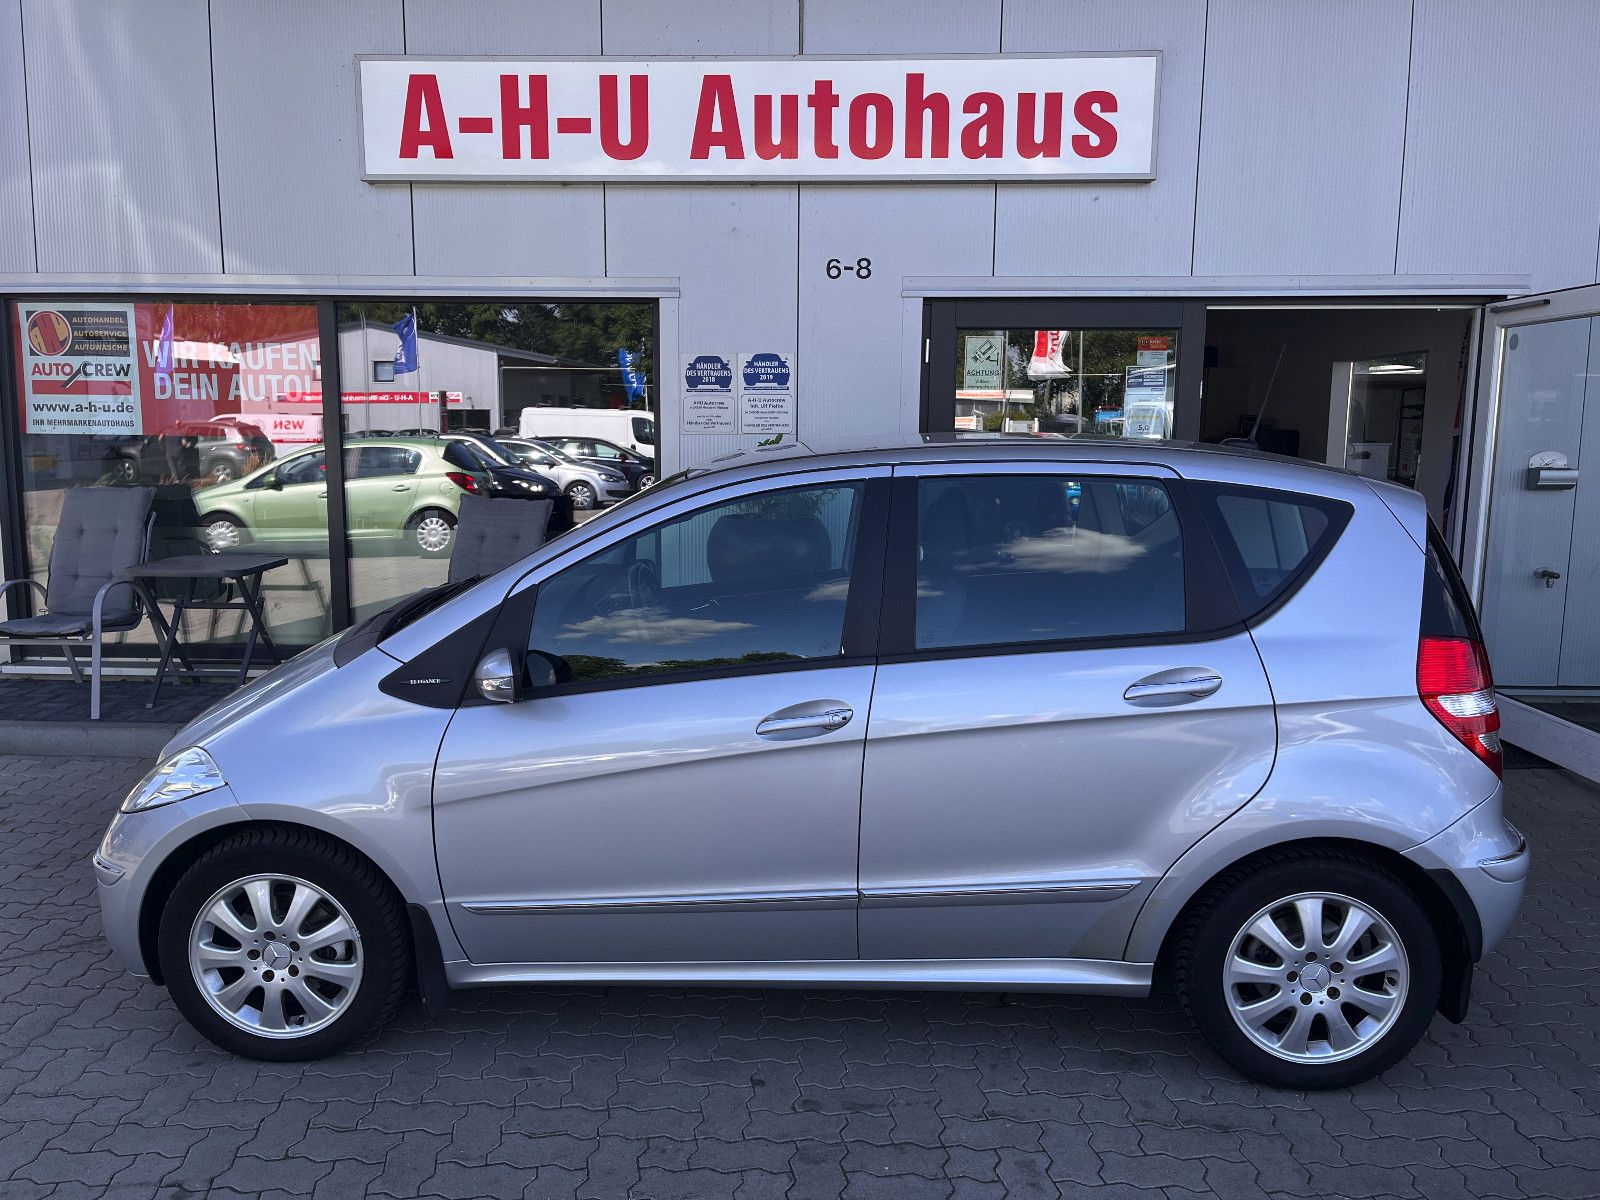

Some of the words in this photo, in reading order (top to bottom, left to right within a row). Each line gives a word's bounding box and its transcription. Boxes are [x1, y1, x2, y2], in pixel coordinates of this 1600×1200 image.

[398, 73, 649, 160] A-H-U
[690, 73, 1119, 160] Autohaus
[825, 257, 873, 280] 6-8
[72, 316, 125, 324] AUTOHANDEL
[143, 340, 199, 369] WIR
[207, 341, 318, 370] KAUFEN
[31, 362, 74, 376] AUTO
[81, 361, 131, 377] CREW
[153, 372, 219, 400] DEIN
[228, 374, 312, 402] AUTO!
[33, 401, 135, 413] www.a-h-u.de
[46, 419, 135, 427] MEHRMARKENAUTOHAUS
